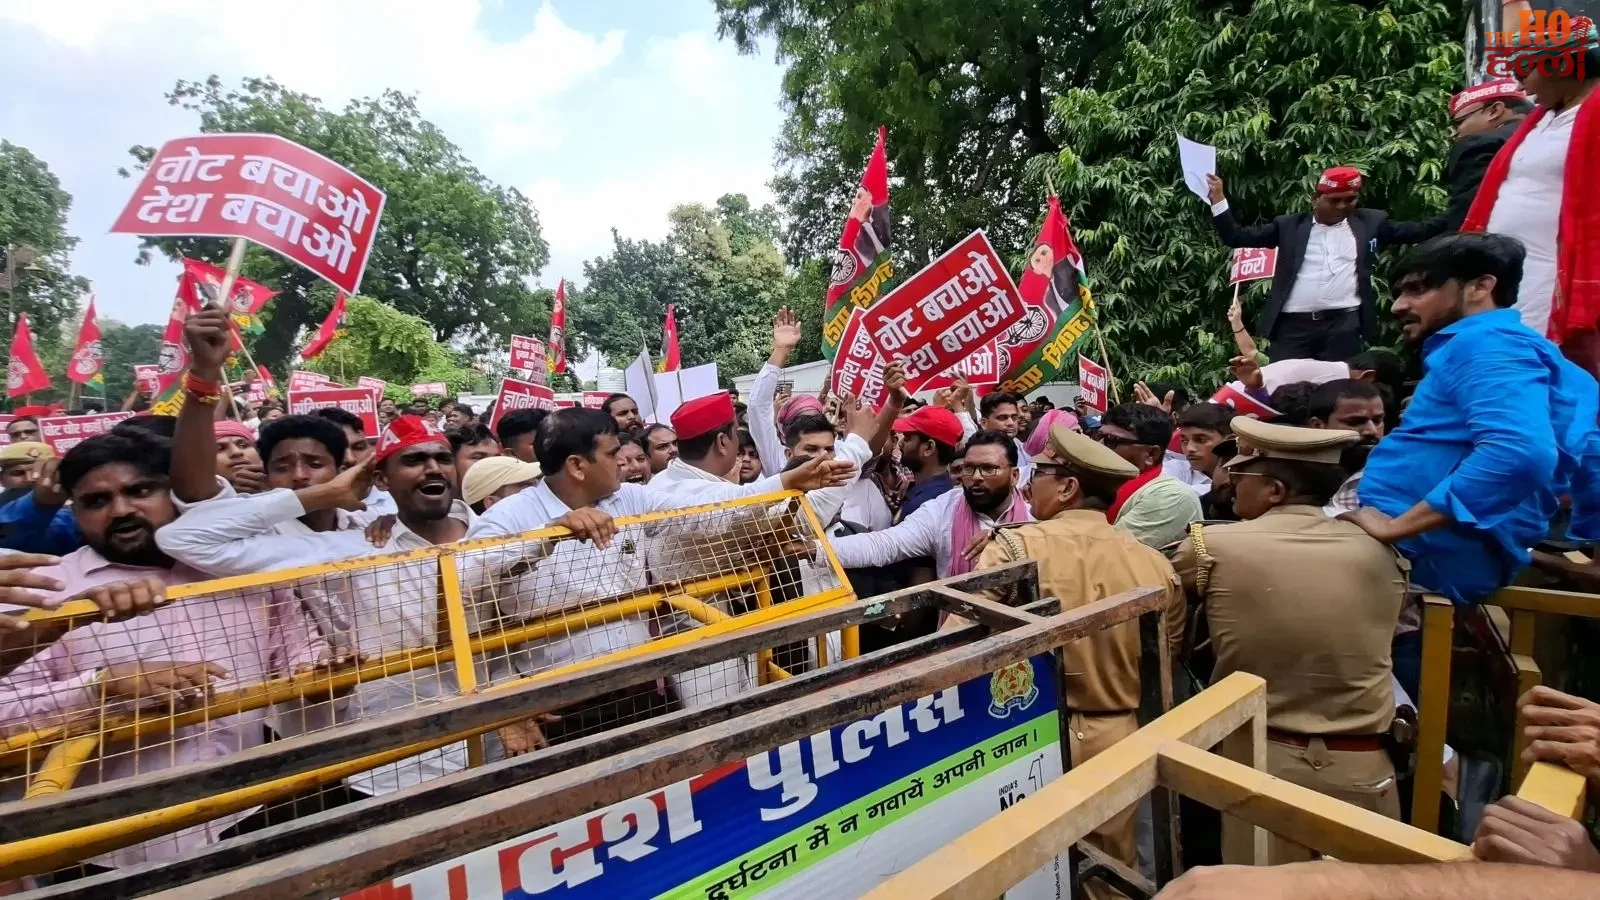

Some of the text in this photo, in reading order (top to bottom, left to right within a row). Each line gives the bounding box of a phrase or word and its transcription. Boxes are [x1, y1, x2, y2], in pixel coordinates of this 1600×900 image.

[137, 186, 357, 274] देश बचाओ
[155, 146, 371, 234] वोट बचाओ
[873, 251, 999, 351] वोट बचाओ
[1240, 251, 1267, 276] करो
[893, 288, 1017, 380] देश बचाओ
[706, 844, 797, 900] दुर्घटना
[806, 825, 829, 852] में
[838, 813, 858, 834] न
[866, 779, 924, 820] गवायें
[933, 749, 985, 789] अपनी
[998, 779, 1019, 796] INDIA'S
